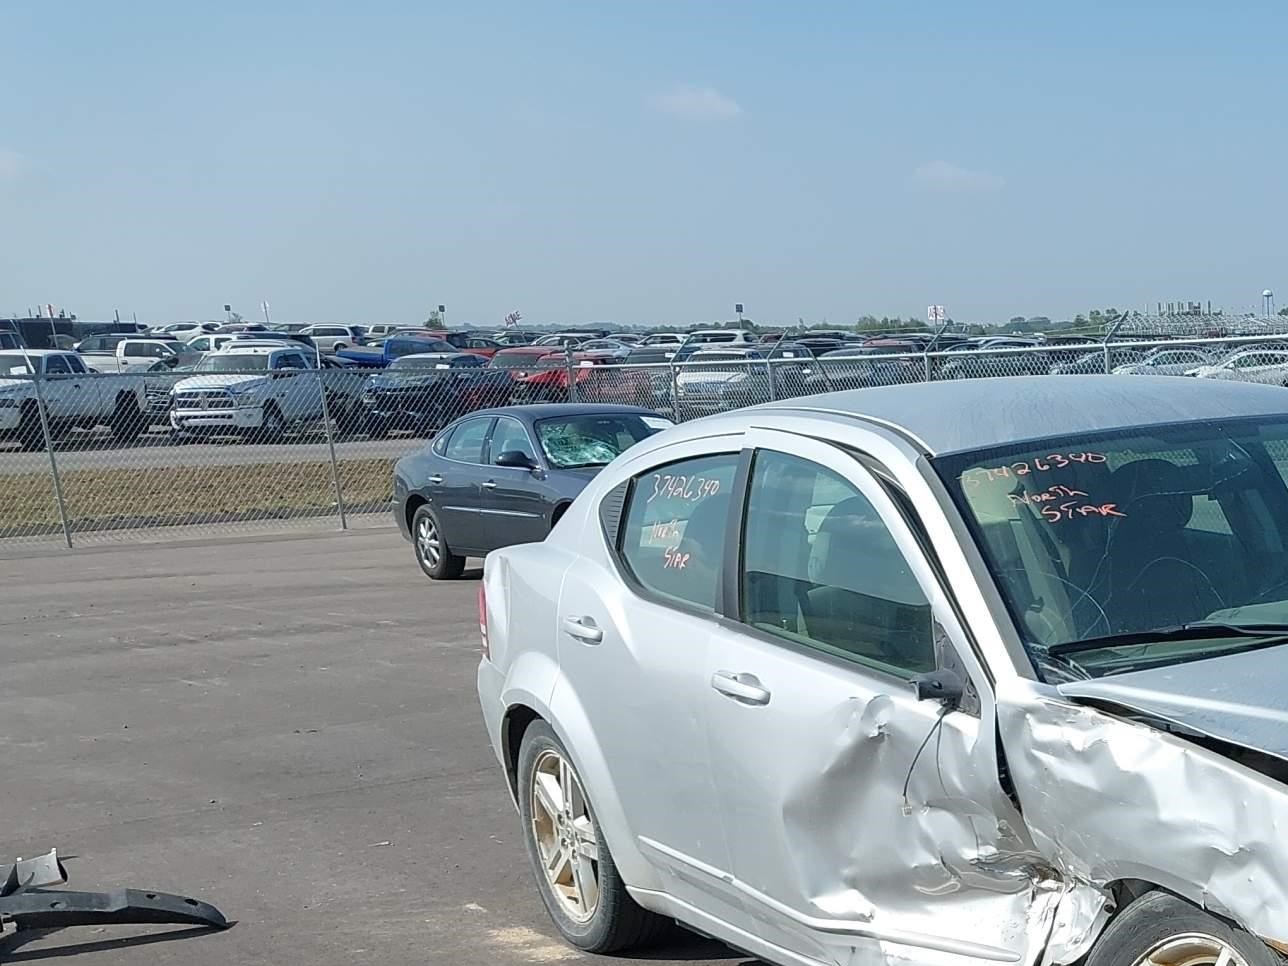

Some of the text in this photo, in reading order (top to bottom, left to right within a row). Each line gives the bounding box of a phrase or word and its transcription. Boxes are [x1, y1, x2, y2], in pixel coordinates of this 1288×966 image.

[956, 452, 1106, 488] 37426340
[647, 474, 720, 503] 37426340
[1041, 501, 1127, 522] STAR
[664, 546, 690, 570] STAR
